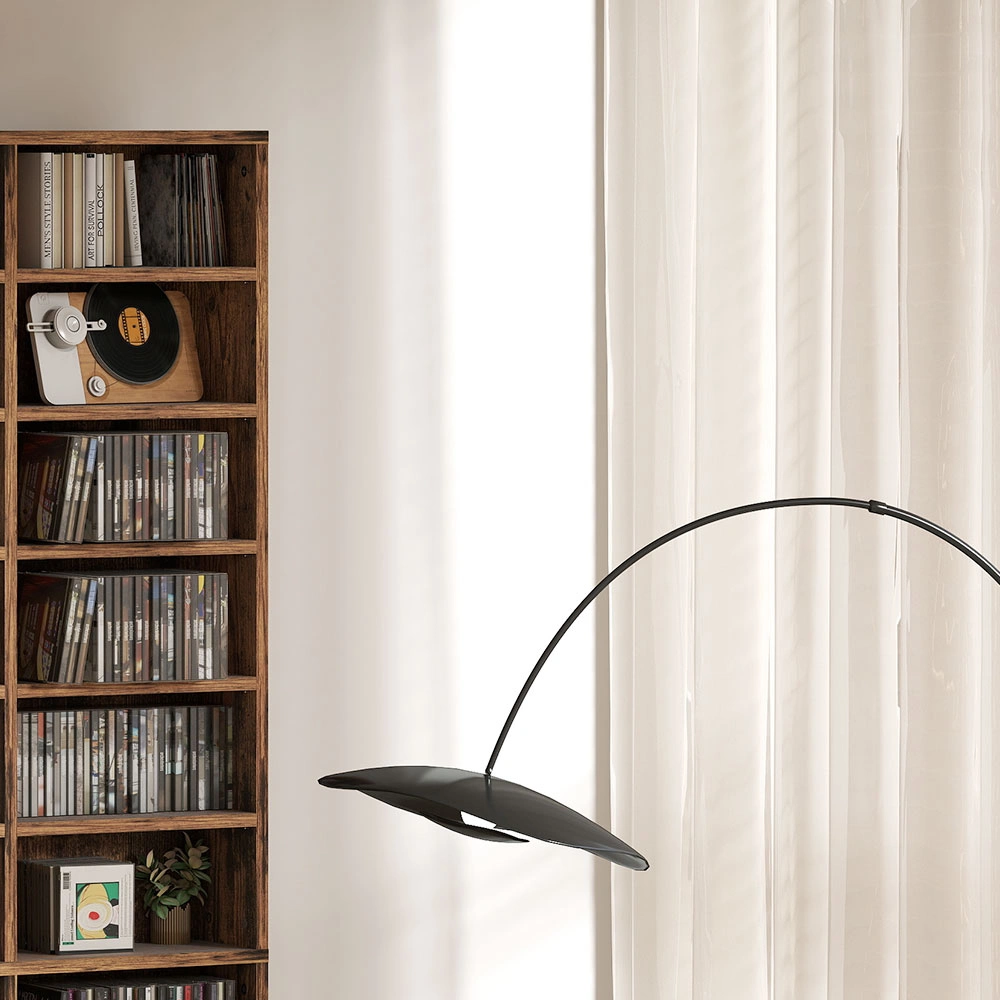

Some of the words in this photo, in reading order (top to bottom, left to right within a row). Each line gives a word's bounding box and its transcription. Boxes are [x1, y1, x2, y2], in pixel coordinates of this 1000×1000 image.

[43, 162, 52, 200] STORIES
[43, 201, 52, 229] STYLE
[43, 231, 52, 258] MEN'S
